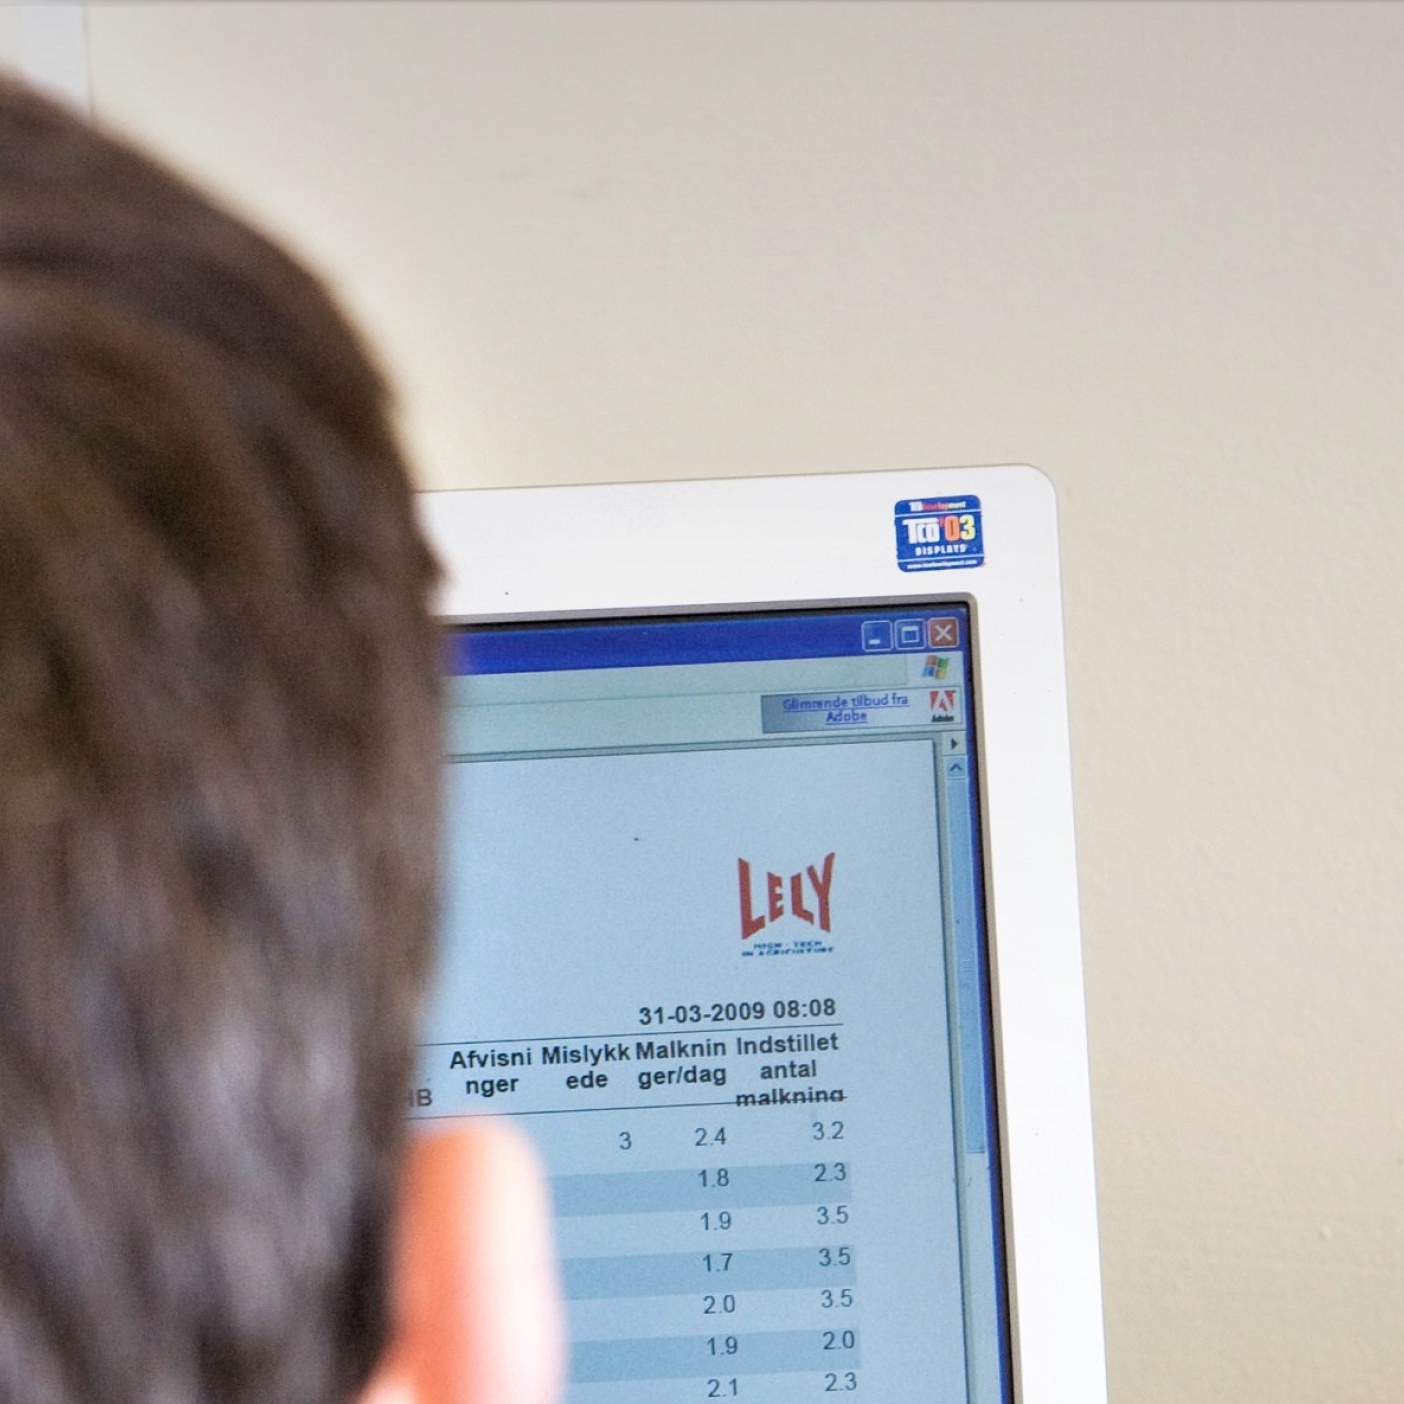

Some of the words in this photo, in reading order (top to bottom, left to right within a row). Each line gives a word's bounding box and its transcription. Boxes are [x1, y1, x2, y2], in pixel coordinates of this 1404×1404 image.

[783, 695, 847, 710] Glimrende
[852, 694, 889, 707] tilbud
[892, 693, 908, 705] fra
[826, 710, 867, 722] Adobe
[738, 852, 835, 940] LELY
[639, 1002, 766, 1026] 31-03-2009
[773, 998, 836, 1018] 08:08
[450, 1048, 531, 1069] Afvisni
[542, 1044, 630, 1066] Mislykk
[636, 1039, 726, 1060] Malknin
[737, 1033, 838, 1055] Indstillet
[466, 1078, 518, 1097] nger
[566, 1071, 608, 1089] ede
[638, 1065, 726, 1090] ger/dag
[761, 1059, 816, 1079] antal
[620, 1132, 632, 1150] 3
[695, 1127, 726, 1146] 2.4
[812, 1121, 844, 1140] 3.2
[699, 1168, 729, 1187] 1.8
[814, 1163, 846, 1182] 2.3
[701, 1211, 731, 1230] 1.9
[817, 1205, 848, 1225] 3.5
[703, 1253, 733, 1272] 1.7
[819, 1247, 850, 1267] 3.5
[703, 1295, 735, 1314] 2.0
[821, 1289, 853, 1308] 3.5
[708, 1336, 738, 1355] 1.9
[823, 1330, 855, 1350] 2.0
[708, 1378, 737, 1397] 2.1
[825, 1372, 857, 1391] 2.3
